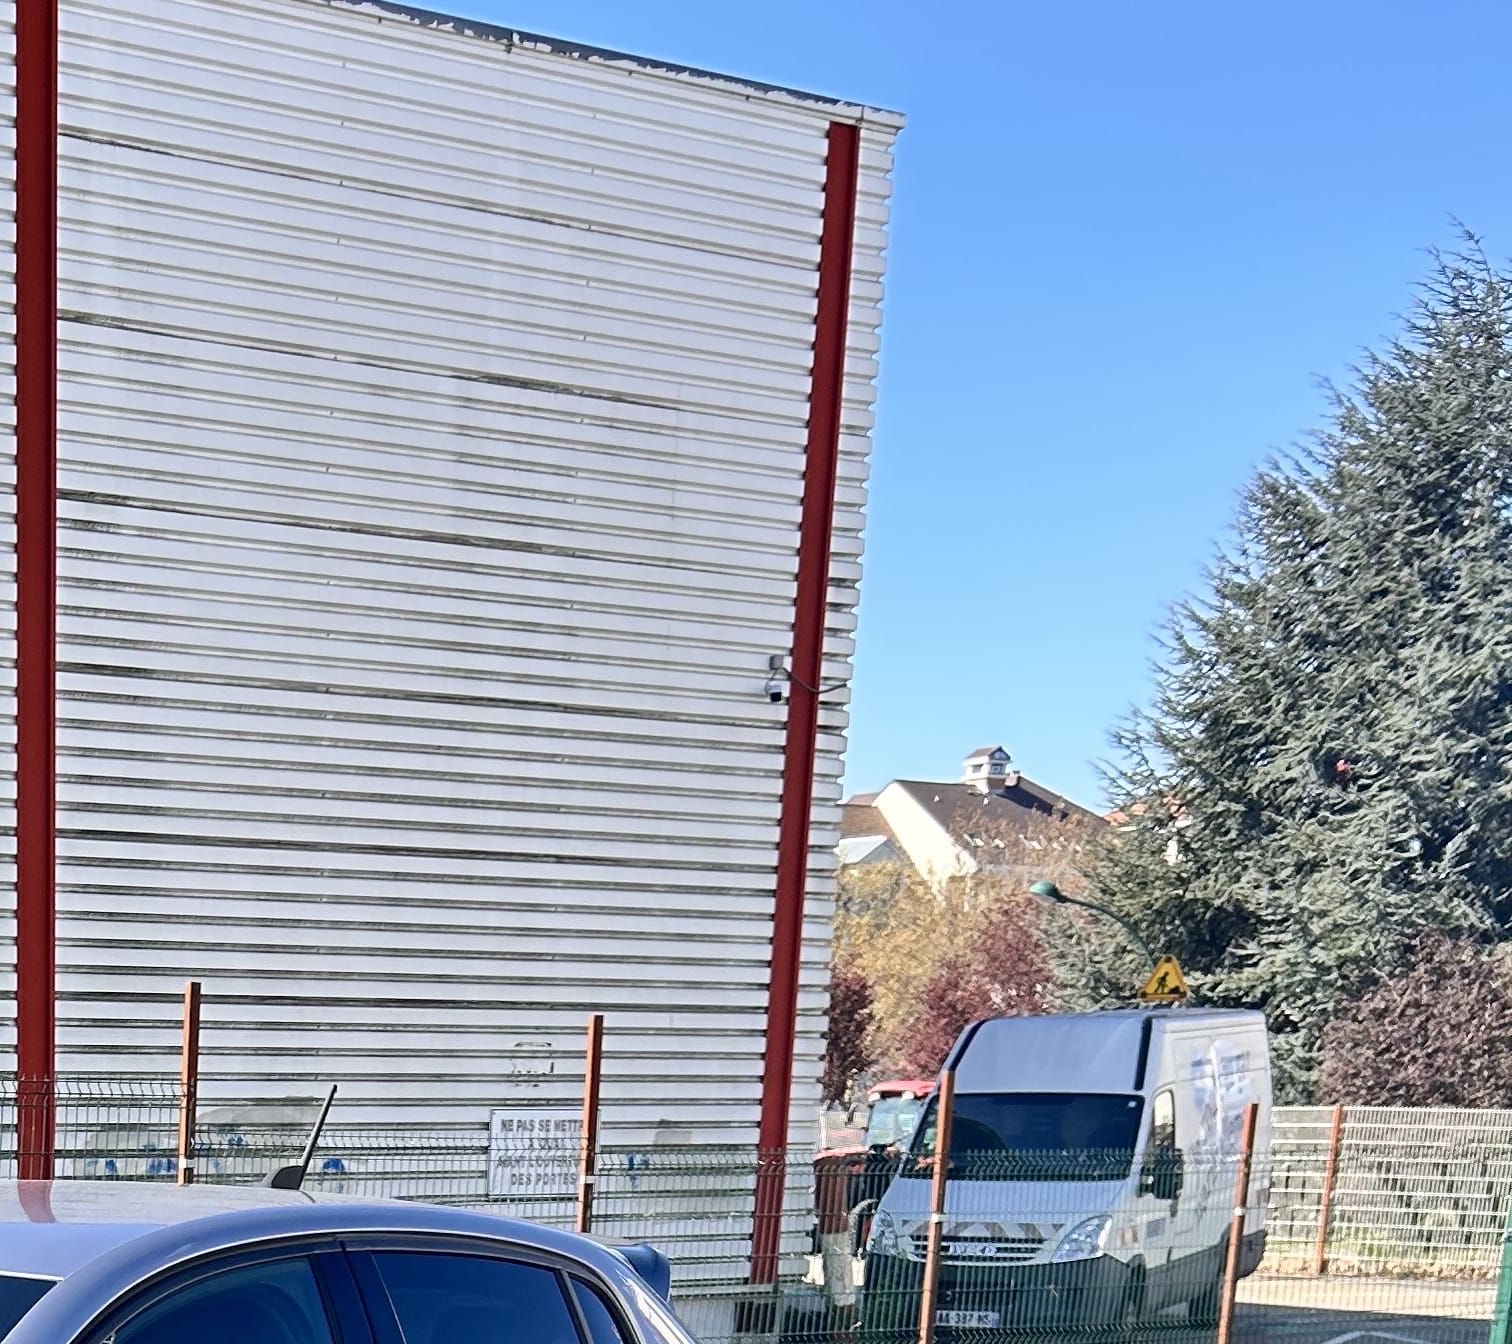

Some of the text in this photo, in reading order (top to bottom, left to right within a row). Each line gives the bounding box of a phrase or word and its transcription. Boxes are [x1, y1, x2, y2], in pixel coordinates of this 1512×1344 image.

[501, 1119, 513, 1132] NE
[516, 1119, 535, 1132] PAS
[538, 1119, 551, 1132] SE
[511, 1172, 576, 1186] DES PORTES
